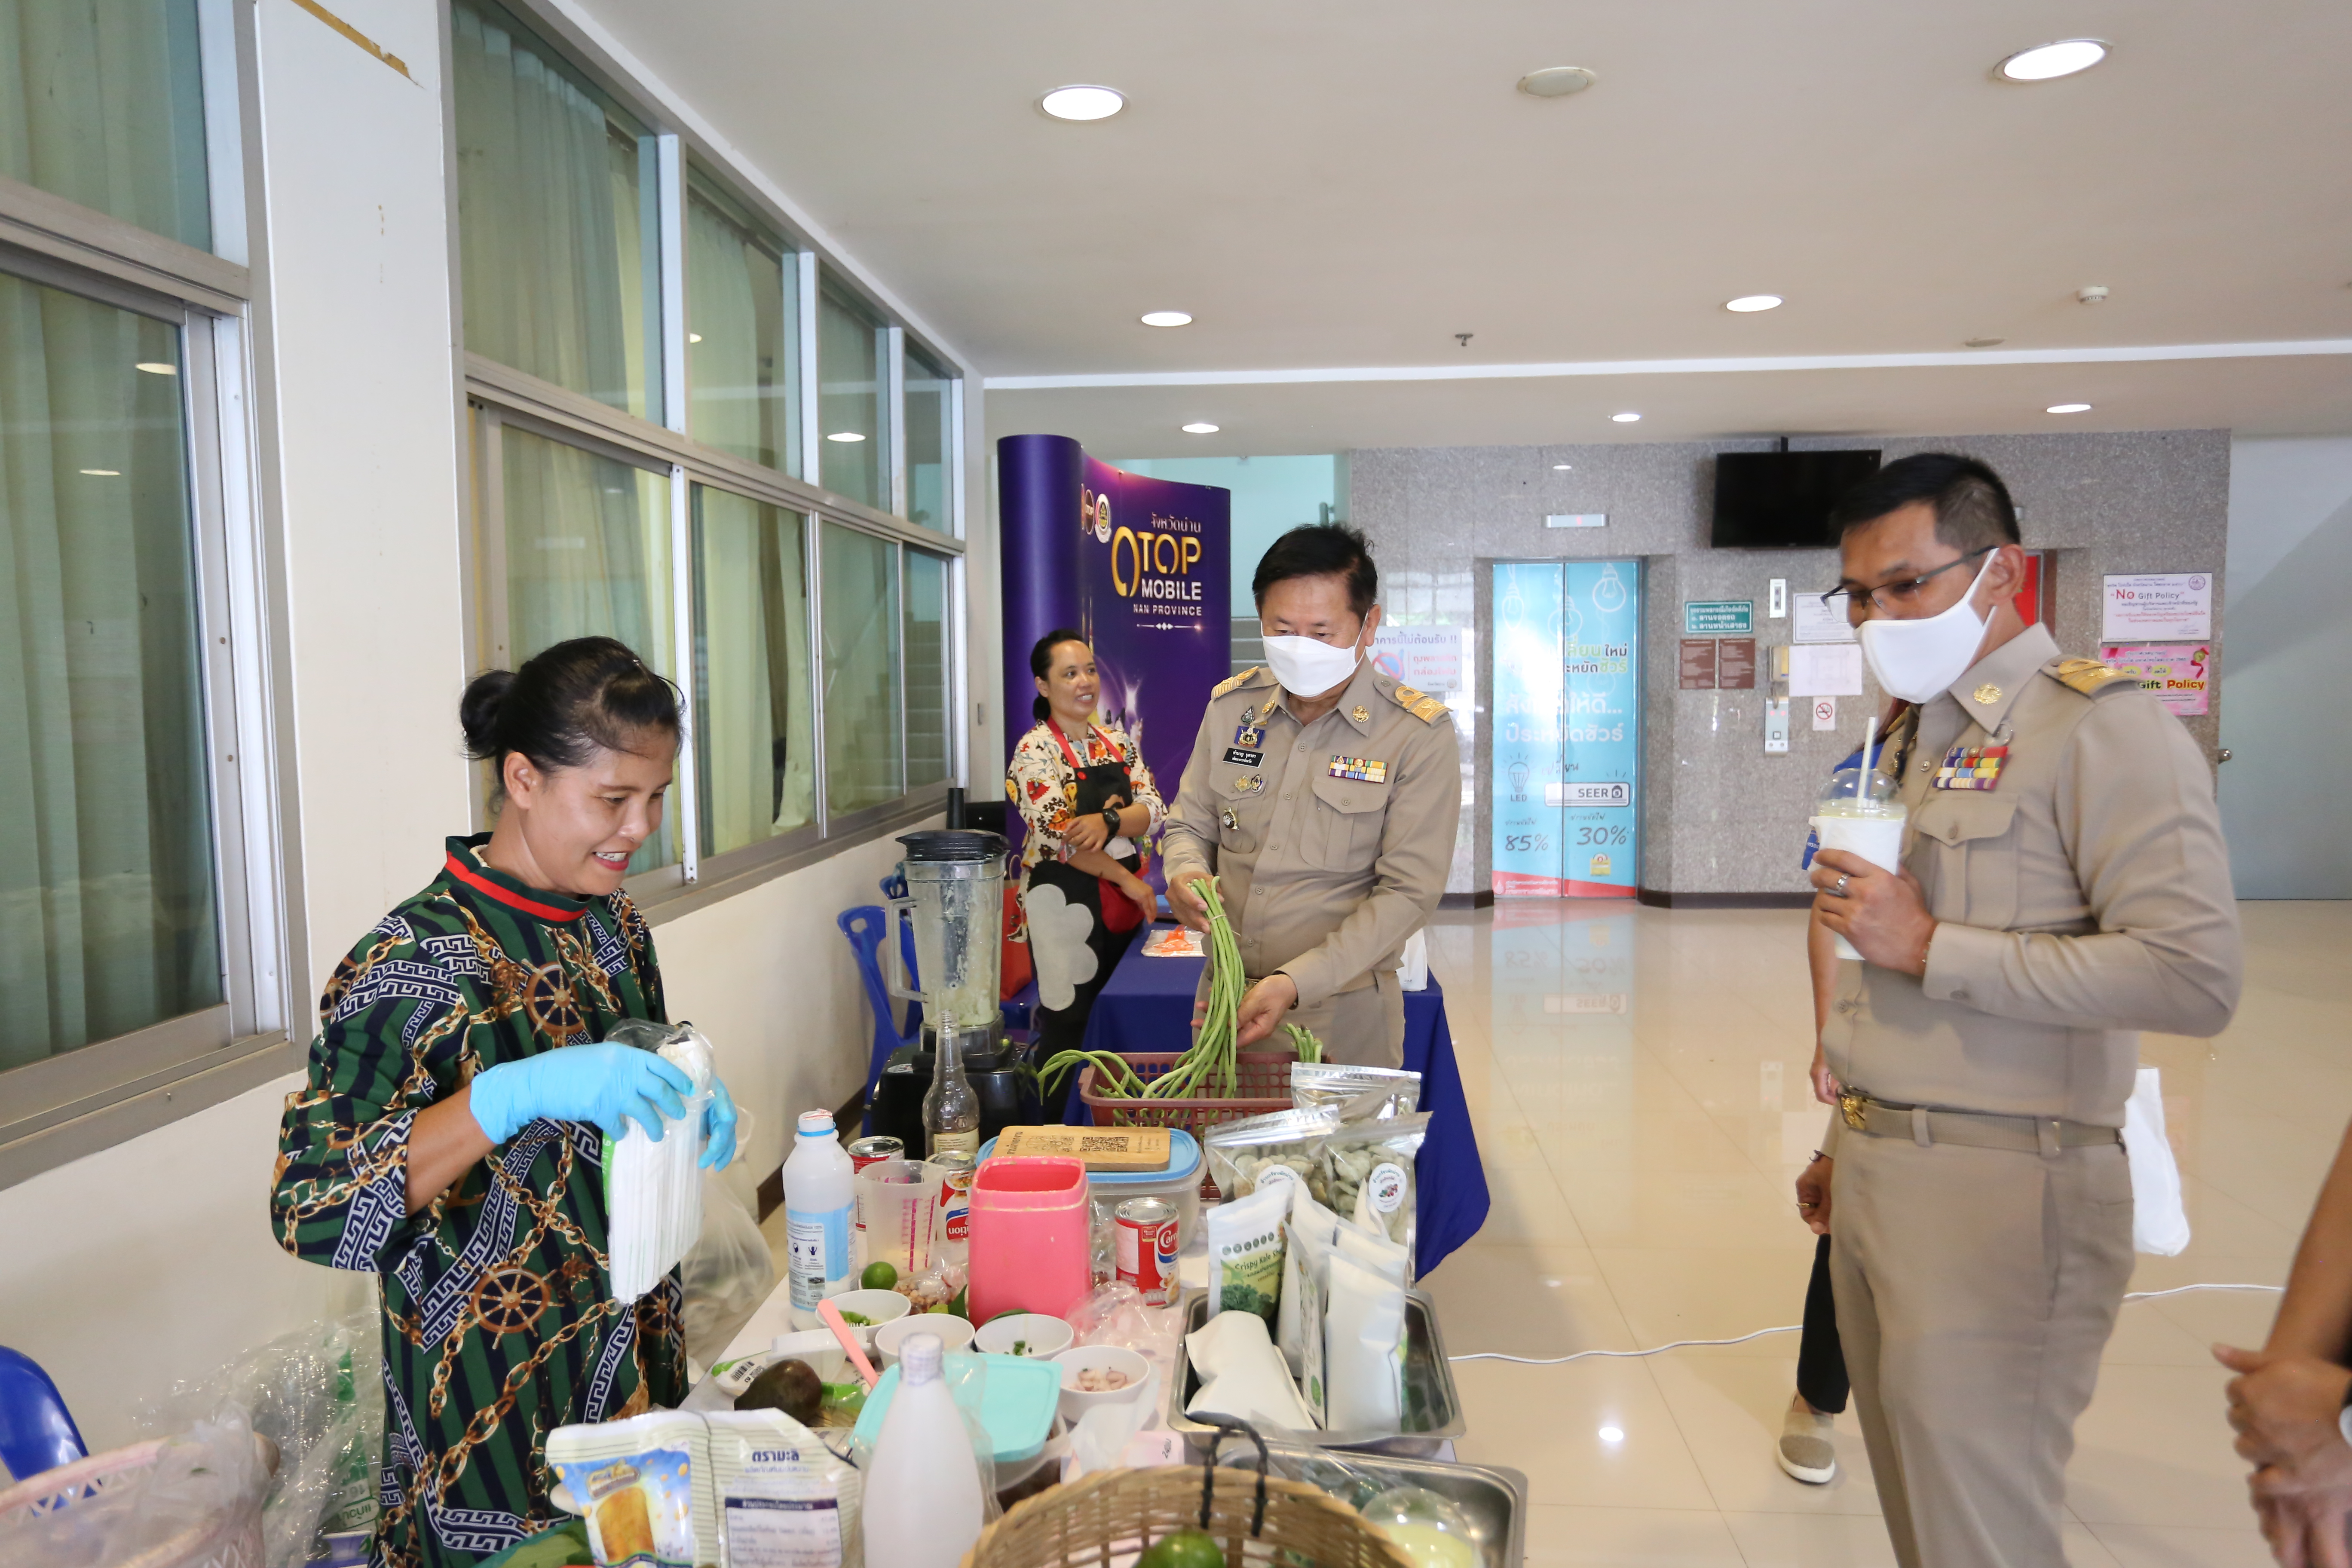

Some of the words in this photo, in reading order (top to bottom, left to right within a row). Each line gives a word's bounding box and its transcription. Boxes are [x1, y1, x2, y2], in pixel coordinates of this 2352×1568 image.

[1152, 511, 1201, 533] จังหวัดน่าน
[1111, 526, 1202, 597] OTOP
[1142, 578, 1202, 600] MOBILE
[1133, 603, 1150, 614] NAN
[1153, 605, 1202, 616] PROVINCE
[1375, 631, 1446, 644] าคารนี้ไม่ต้อนรับ
[1567, 635, 1601, 657] ลี่ยน
[1605, 643, 1627, 656] ใหม่
[2167, 680, 2204, 690] Policy
[1578, 788, 1608, 798] SEER
[1505, 833, 1549, 851] 85%
[1577, 825, 1627, 845] 30%
[1235, 1260, 1258, 1270] Crispy
[1259, 1253, 1271, 1264] Kale
[752, 1448, 799, 1462] ตรามะลิ
